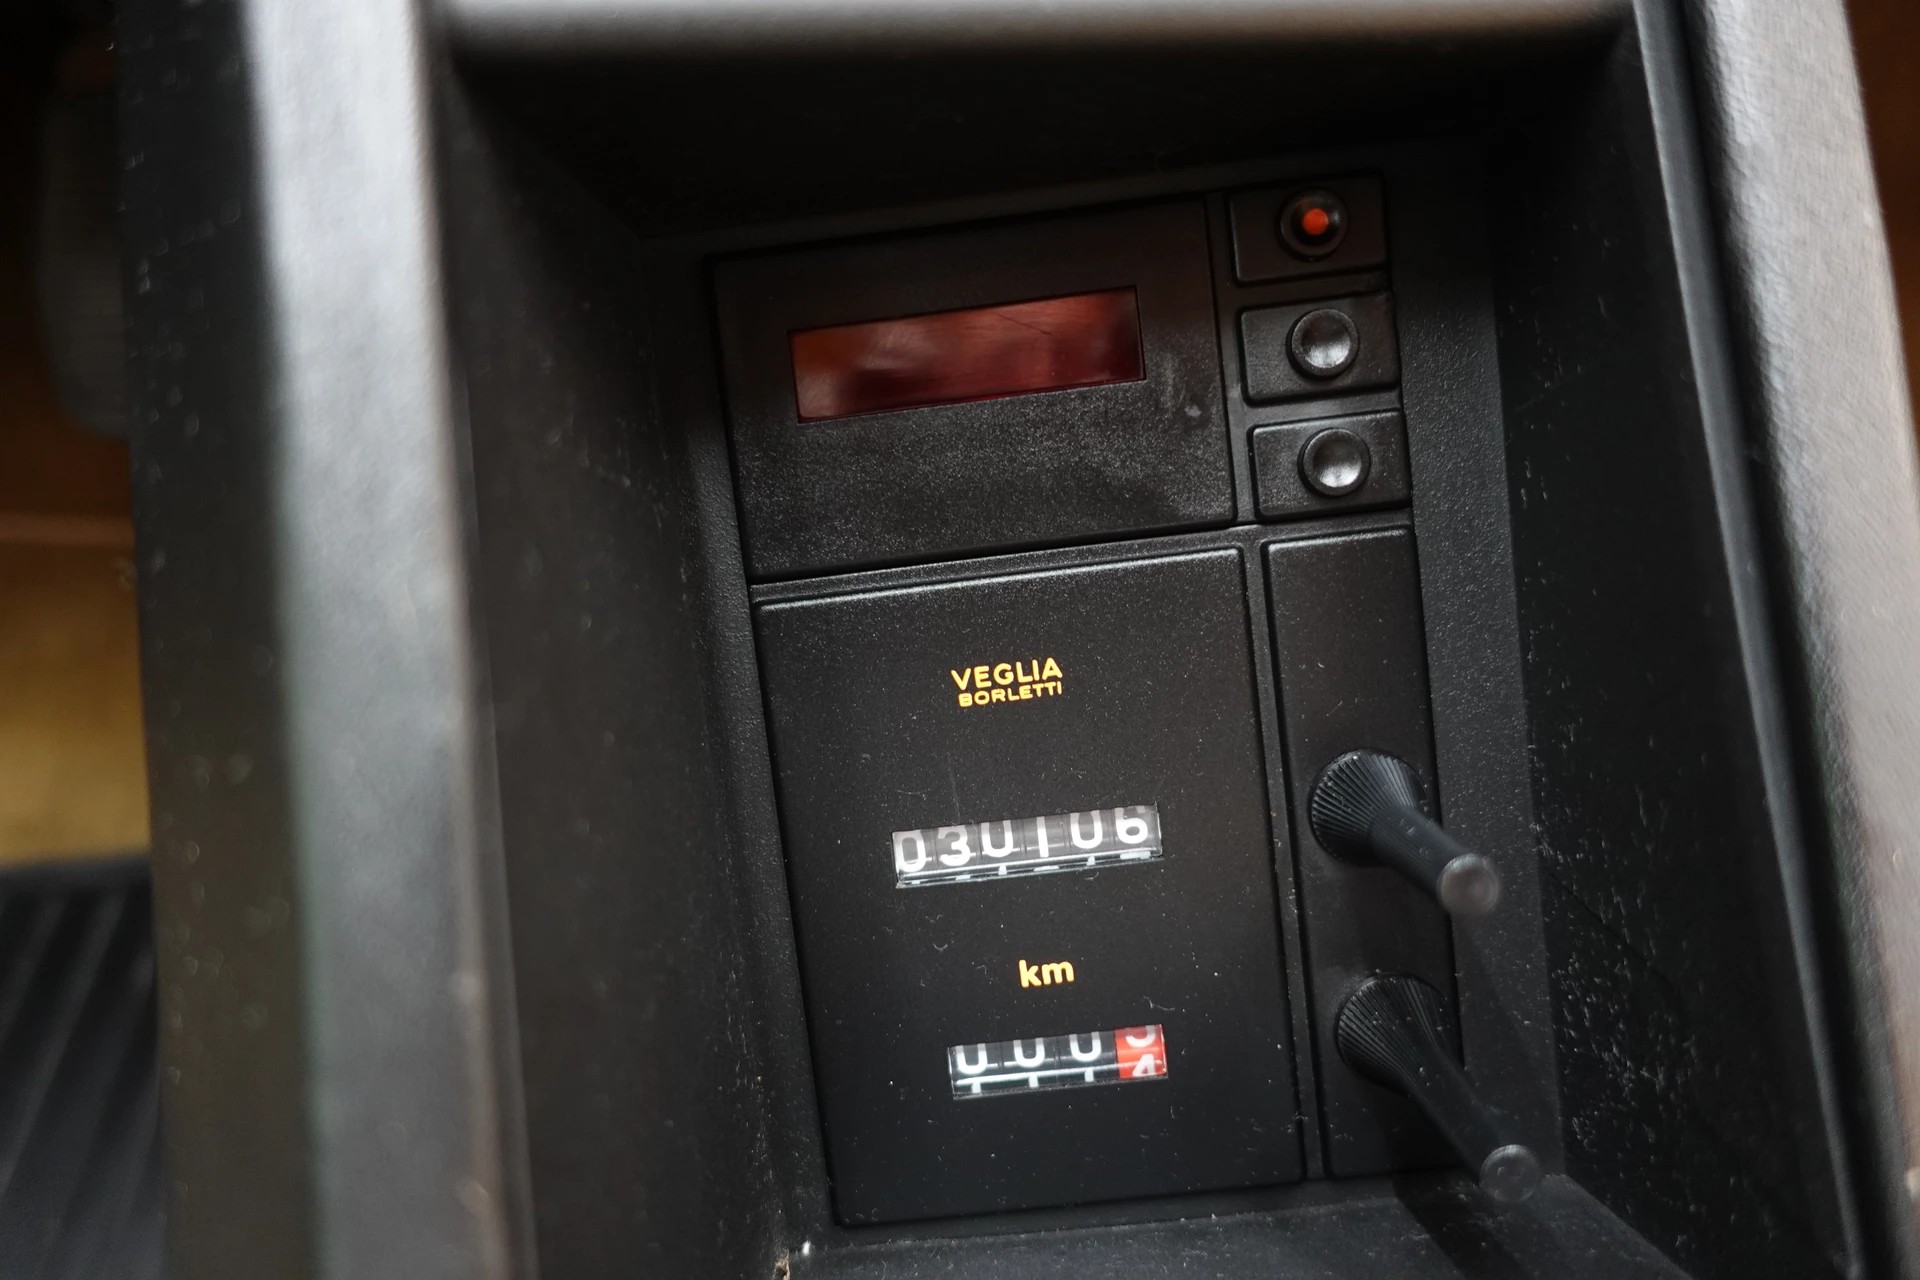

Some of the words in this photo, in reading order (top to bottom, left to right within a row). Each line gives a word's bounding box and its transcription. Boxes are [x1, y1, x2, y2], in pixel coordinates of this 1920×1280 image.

[950, 657, 1063, 691] VEGLIA
[958, 681, 1063, 708] BORLETTI
[1018, 959, 1075, 988] km
